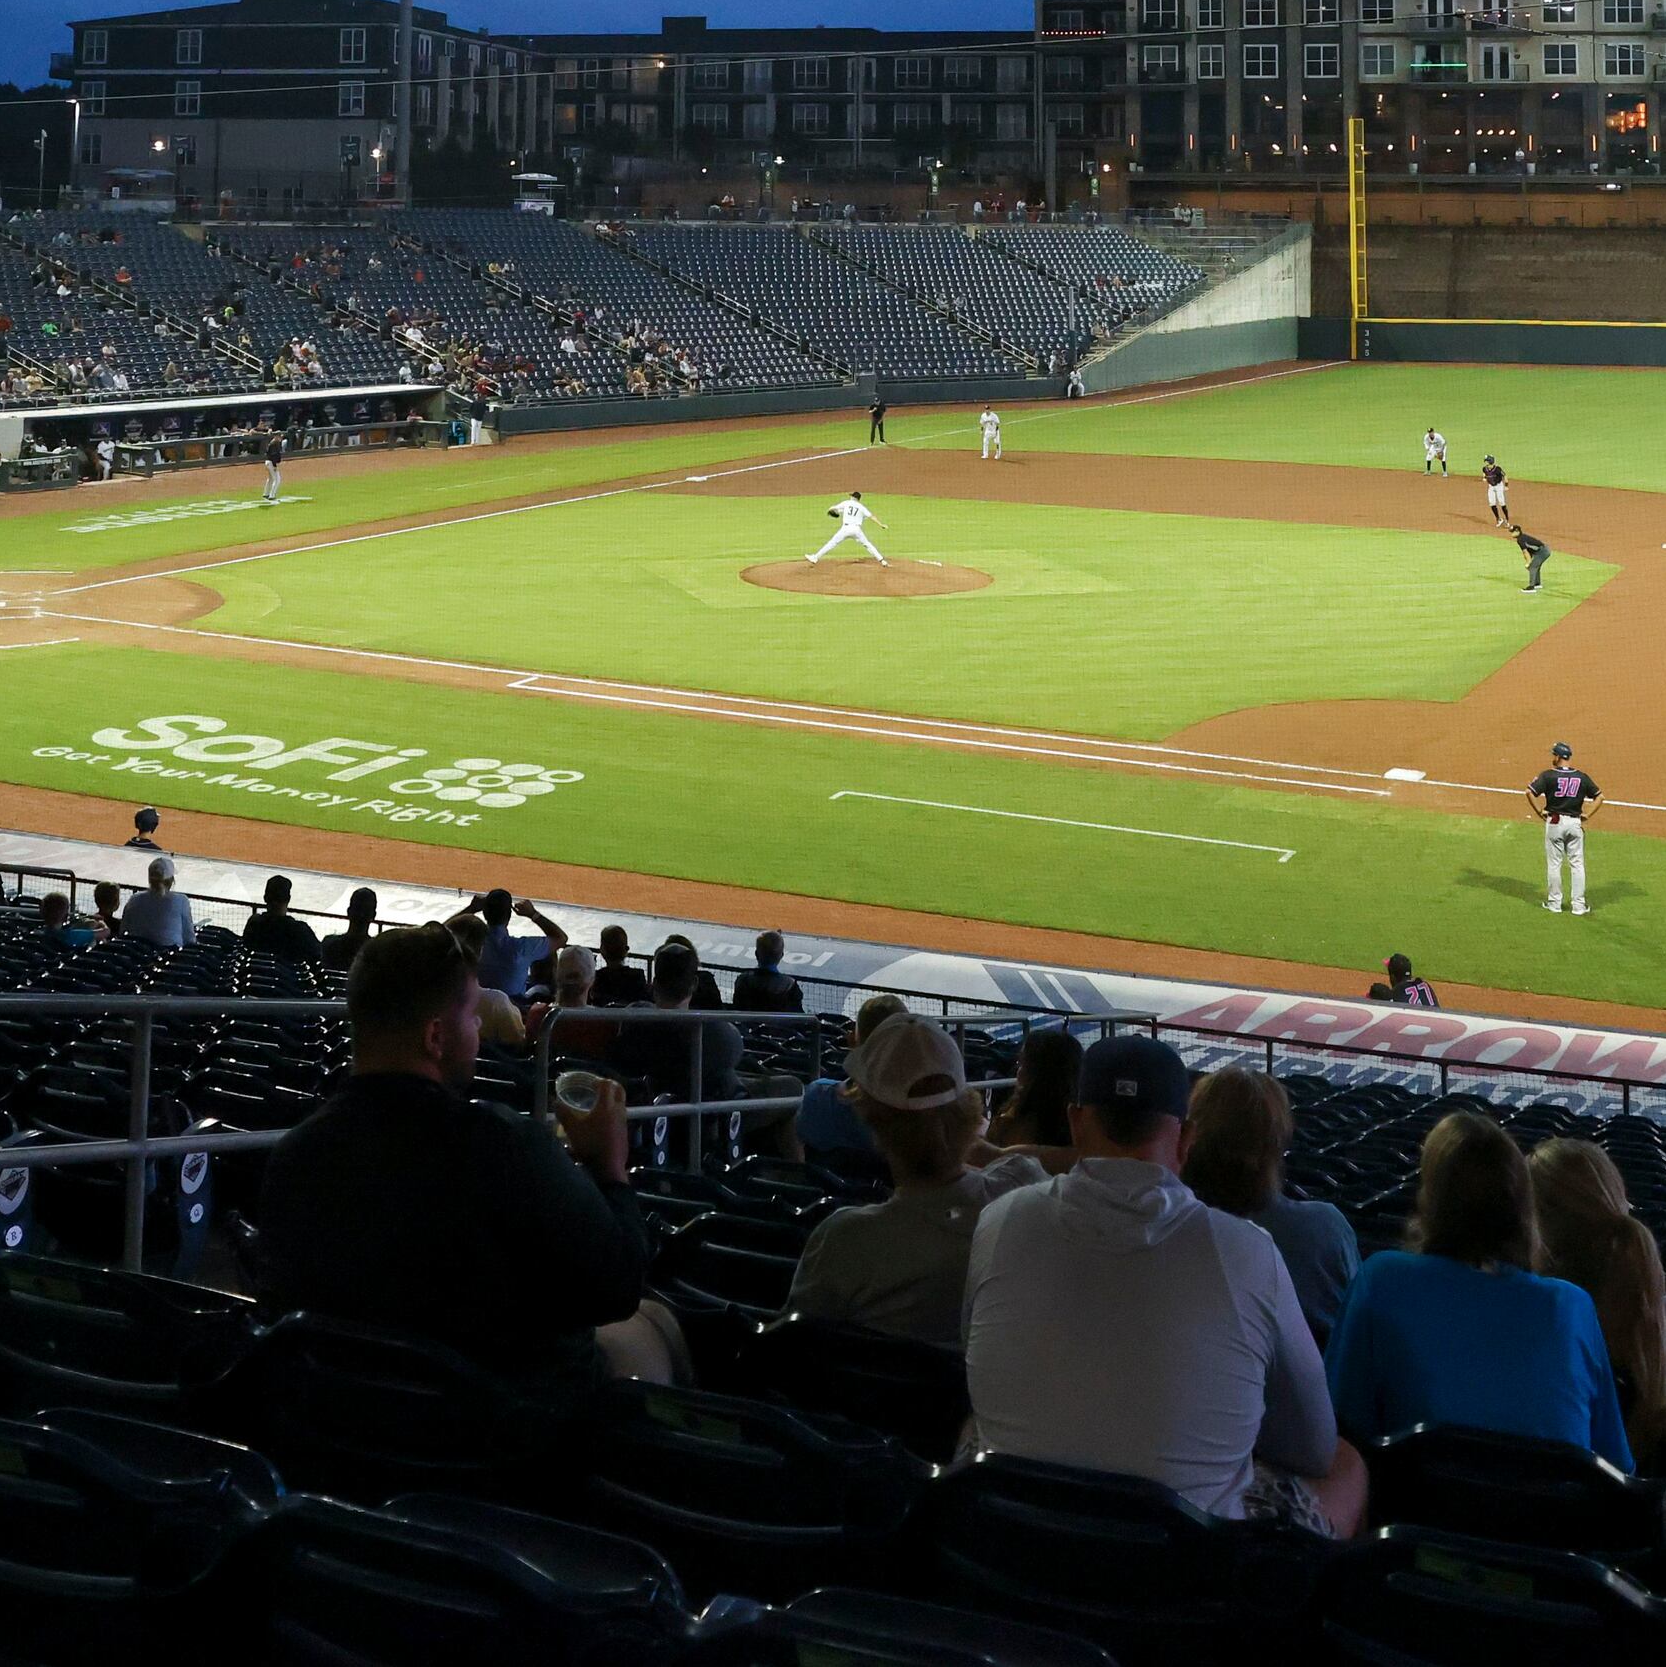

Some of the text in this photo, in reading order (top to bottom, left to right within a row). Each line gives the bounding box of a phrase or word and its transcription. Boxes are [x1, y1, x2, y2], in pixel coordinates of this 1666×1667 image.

[847, 505, 859, 517] 37
[91, 715, 429, 782] SoFi
[32, 745, 483, 827] Get Your Money Right
[1554, 777, 1582, 798] 30
[1404, 981, 1435, 1006] 27
